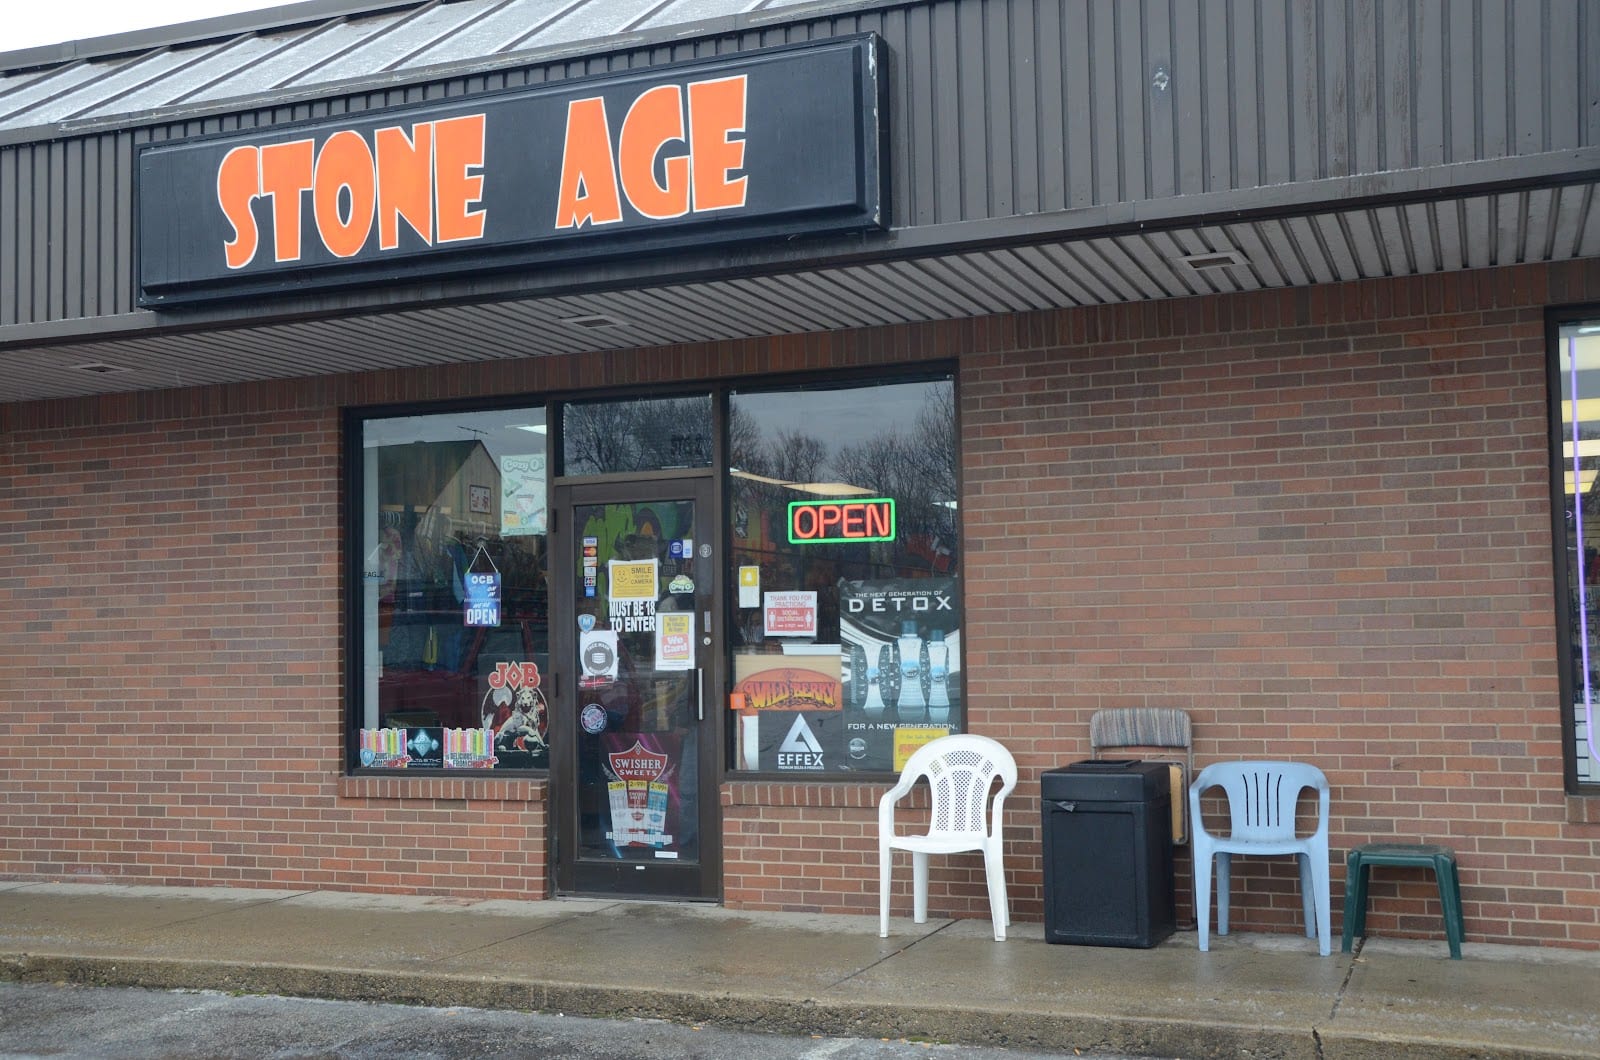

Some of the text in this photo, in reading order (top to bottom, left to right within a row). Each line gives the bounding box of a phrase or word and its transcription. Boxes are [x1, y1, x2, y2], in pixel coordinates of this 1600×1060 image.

[218, 74, 749, 269] STONE AGE
[793, 502, 890, 539] OPEN
[631, 566, 653, 575] SMILE
[471, 575, 494, 585] OCB
[609, 601, 656, 617] MUST BE 18
[848, 595, 953, 613] DETOX
[466, 608, 497, 626] OPEN
[610, 616, 656, 633] TO ENTER
[488, 660, 542, 691] JOB
[744, 680, 836, 708] WILD BERRY
[615, 758, 662, 770] SWISHER
[777, 753, 824, 767] EFFEX
[619, 769, 657, 777] SWEETS
